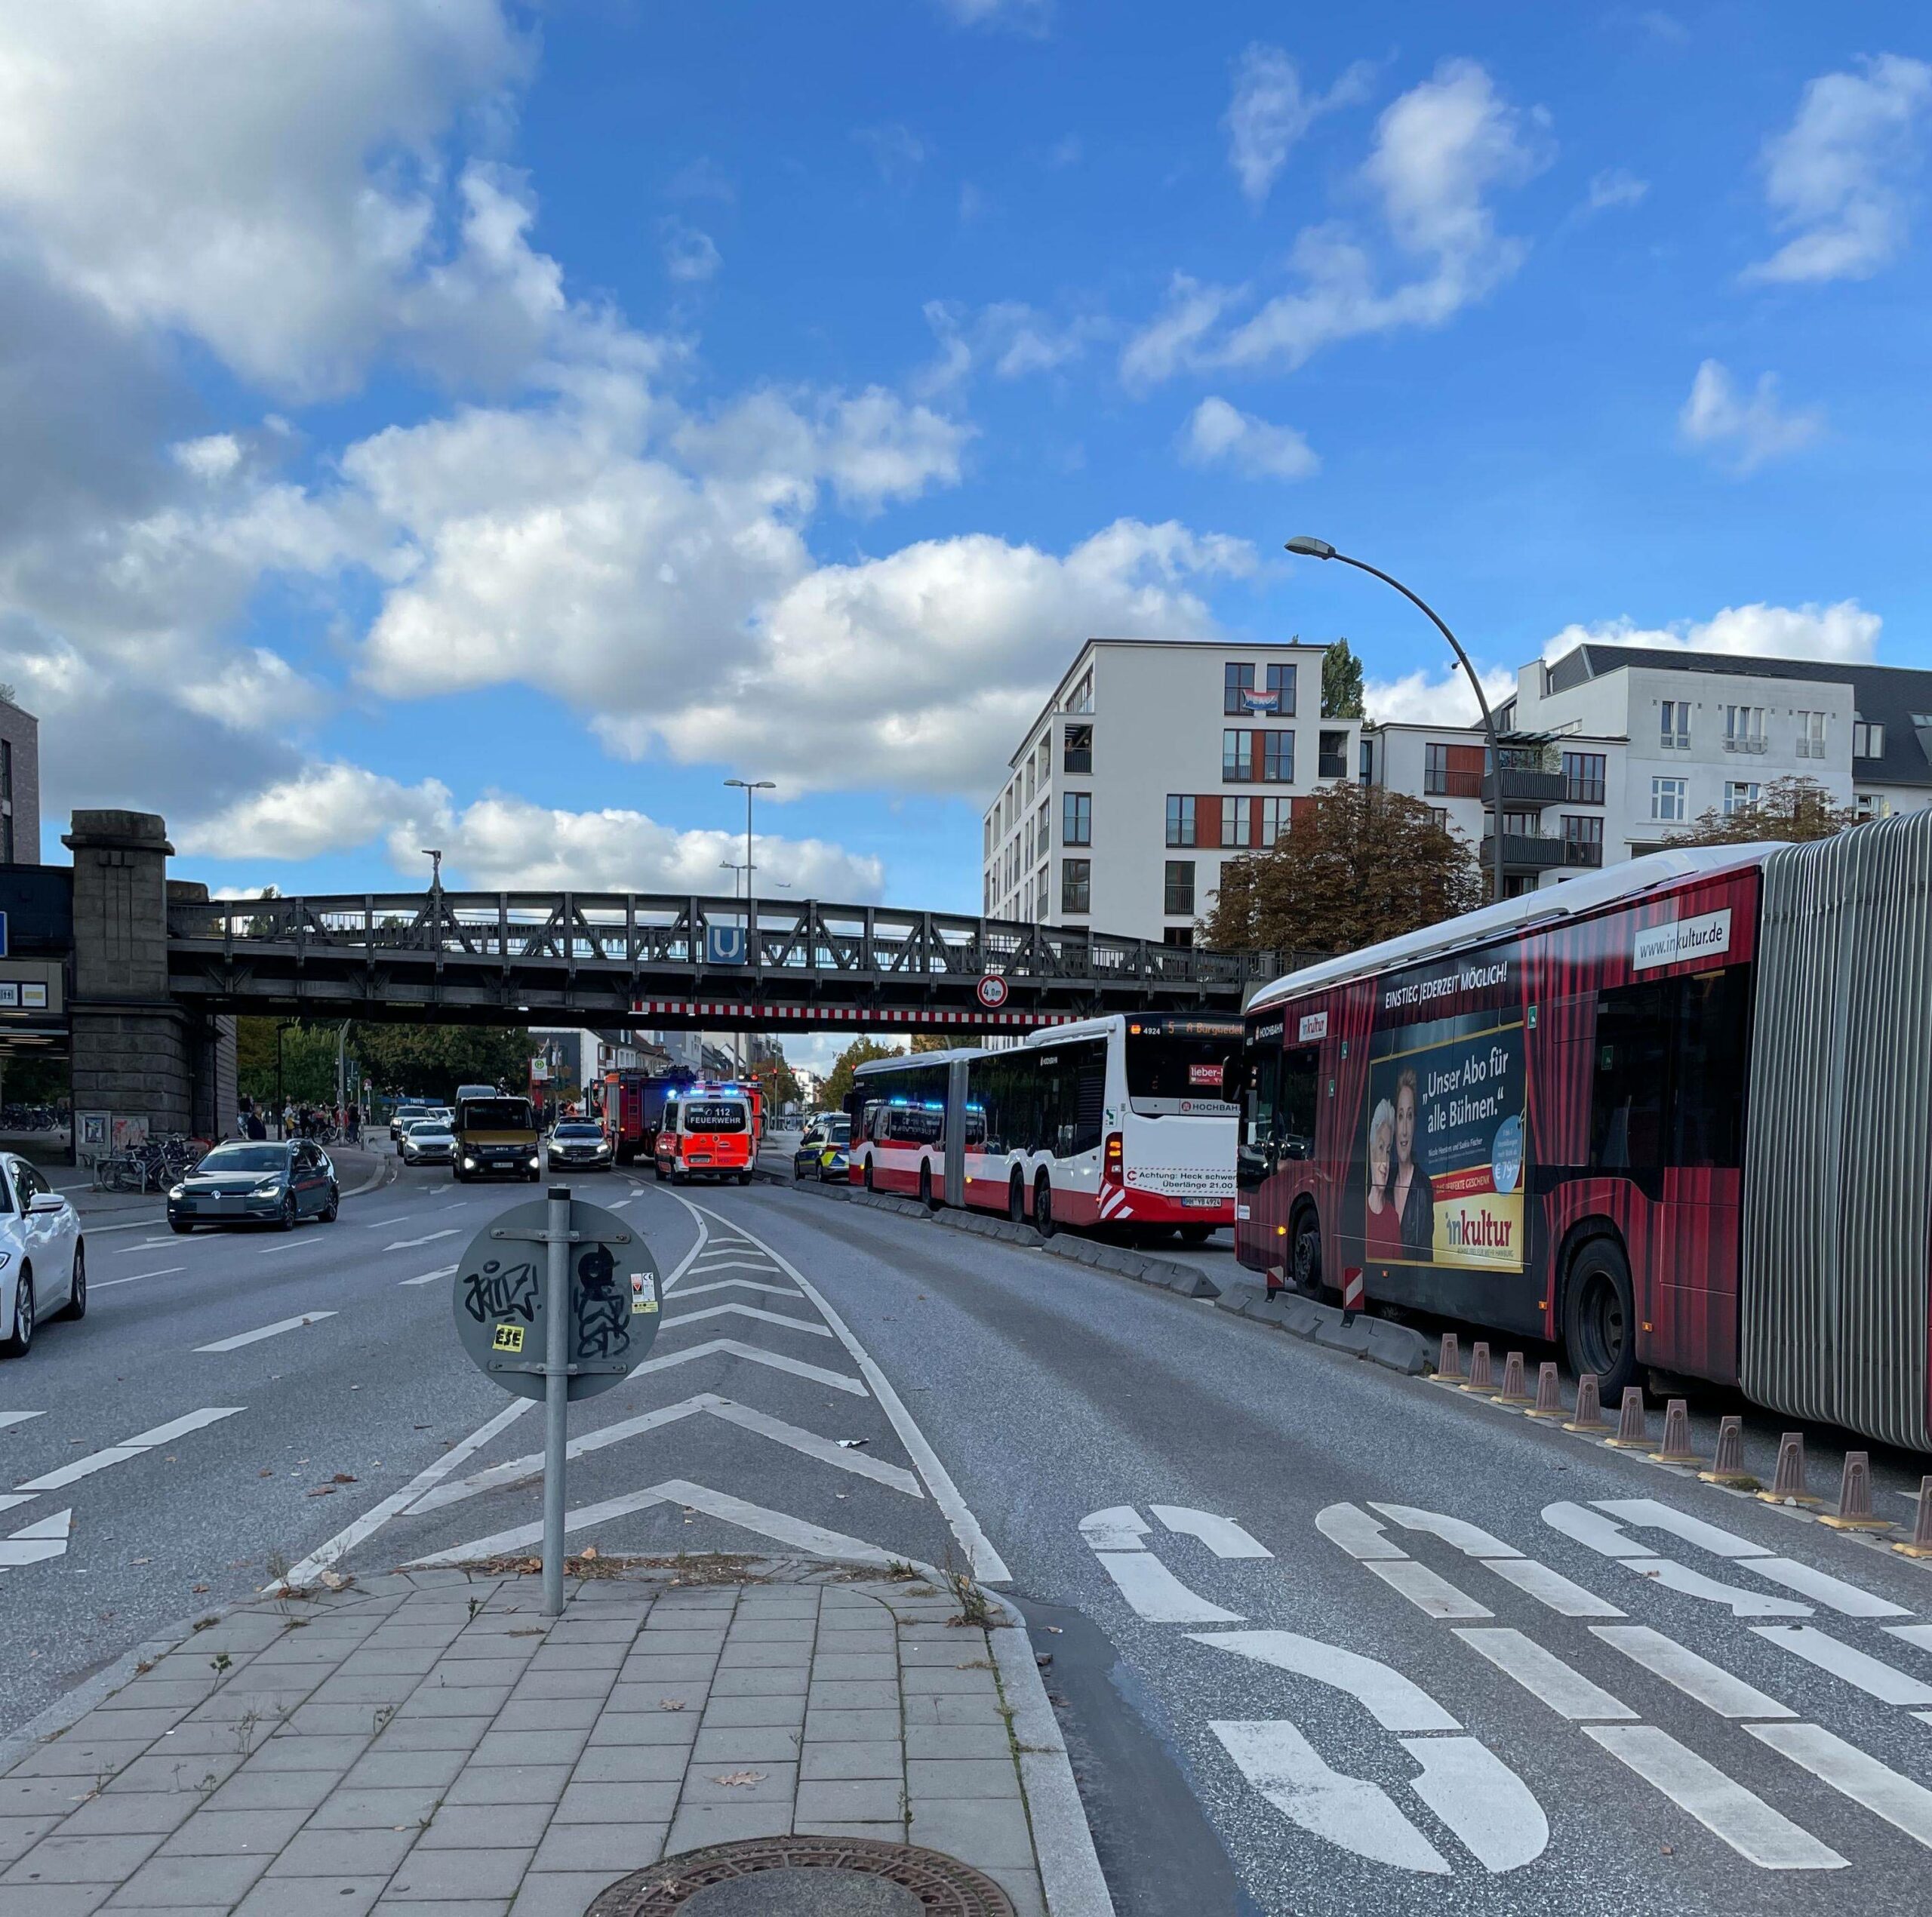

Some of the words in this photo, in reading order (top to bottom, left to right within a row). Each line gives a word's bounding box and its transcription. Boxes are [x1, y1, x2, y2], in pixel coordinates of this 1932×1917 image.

[714, 929, 740, 958] U
[1640, 922, 1723, 958] www.inkultur.de
[1385, 984, 1419, 1009] EINSTIEG
[1419, 974, 1459, 1006] JEDERZEIT
[1460, 961, 1508, 992] MÖGLICH!
[1143, 1027, 1161, 1035] 4924
[1168, 1021, 1175, 1034] 5
[1196, 1022, 1244, 1036] Burgwedel
[1463, 1054, 1487, 1086] Abo
[1490, 1047, 1509, 1078] für
[715, 1108, 731, 1116] 112
[1428, 1103, 1447, 1133] alle
[1162, 1180, 1207, 1189] Überlänge
[1466, 1174, 1491, 1189] GESCHENK
[1445, 1209, 1512, 1247] inkultur
